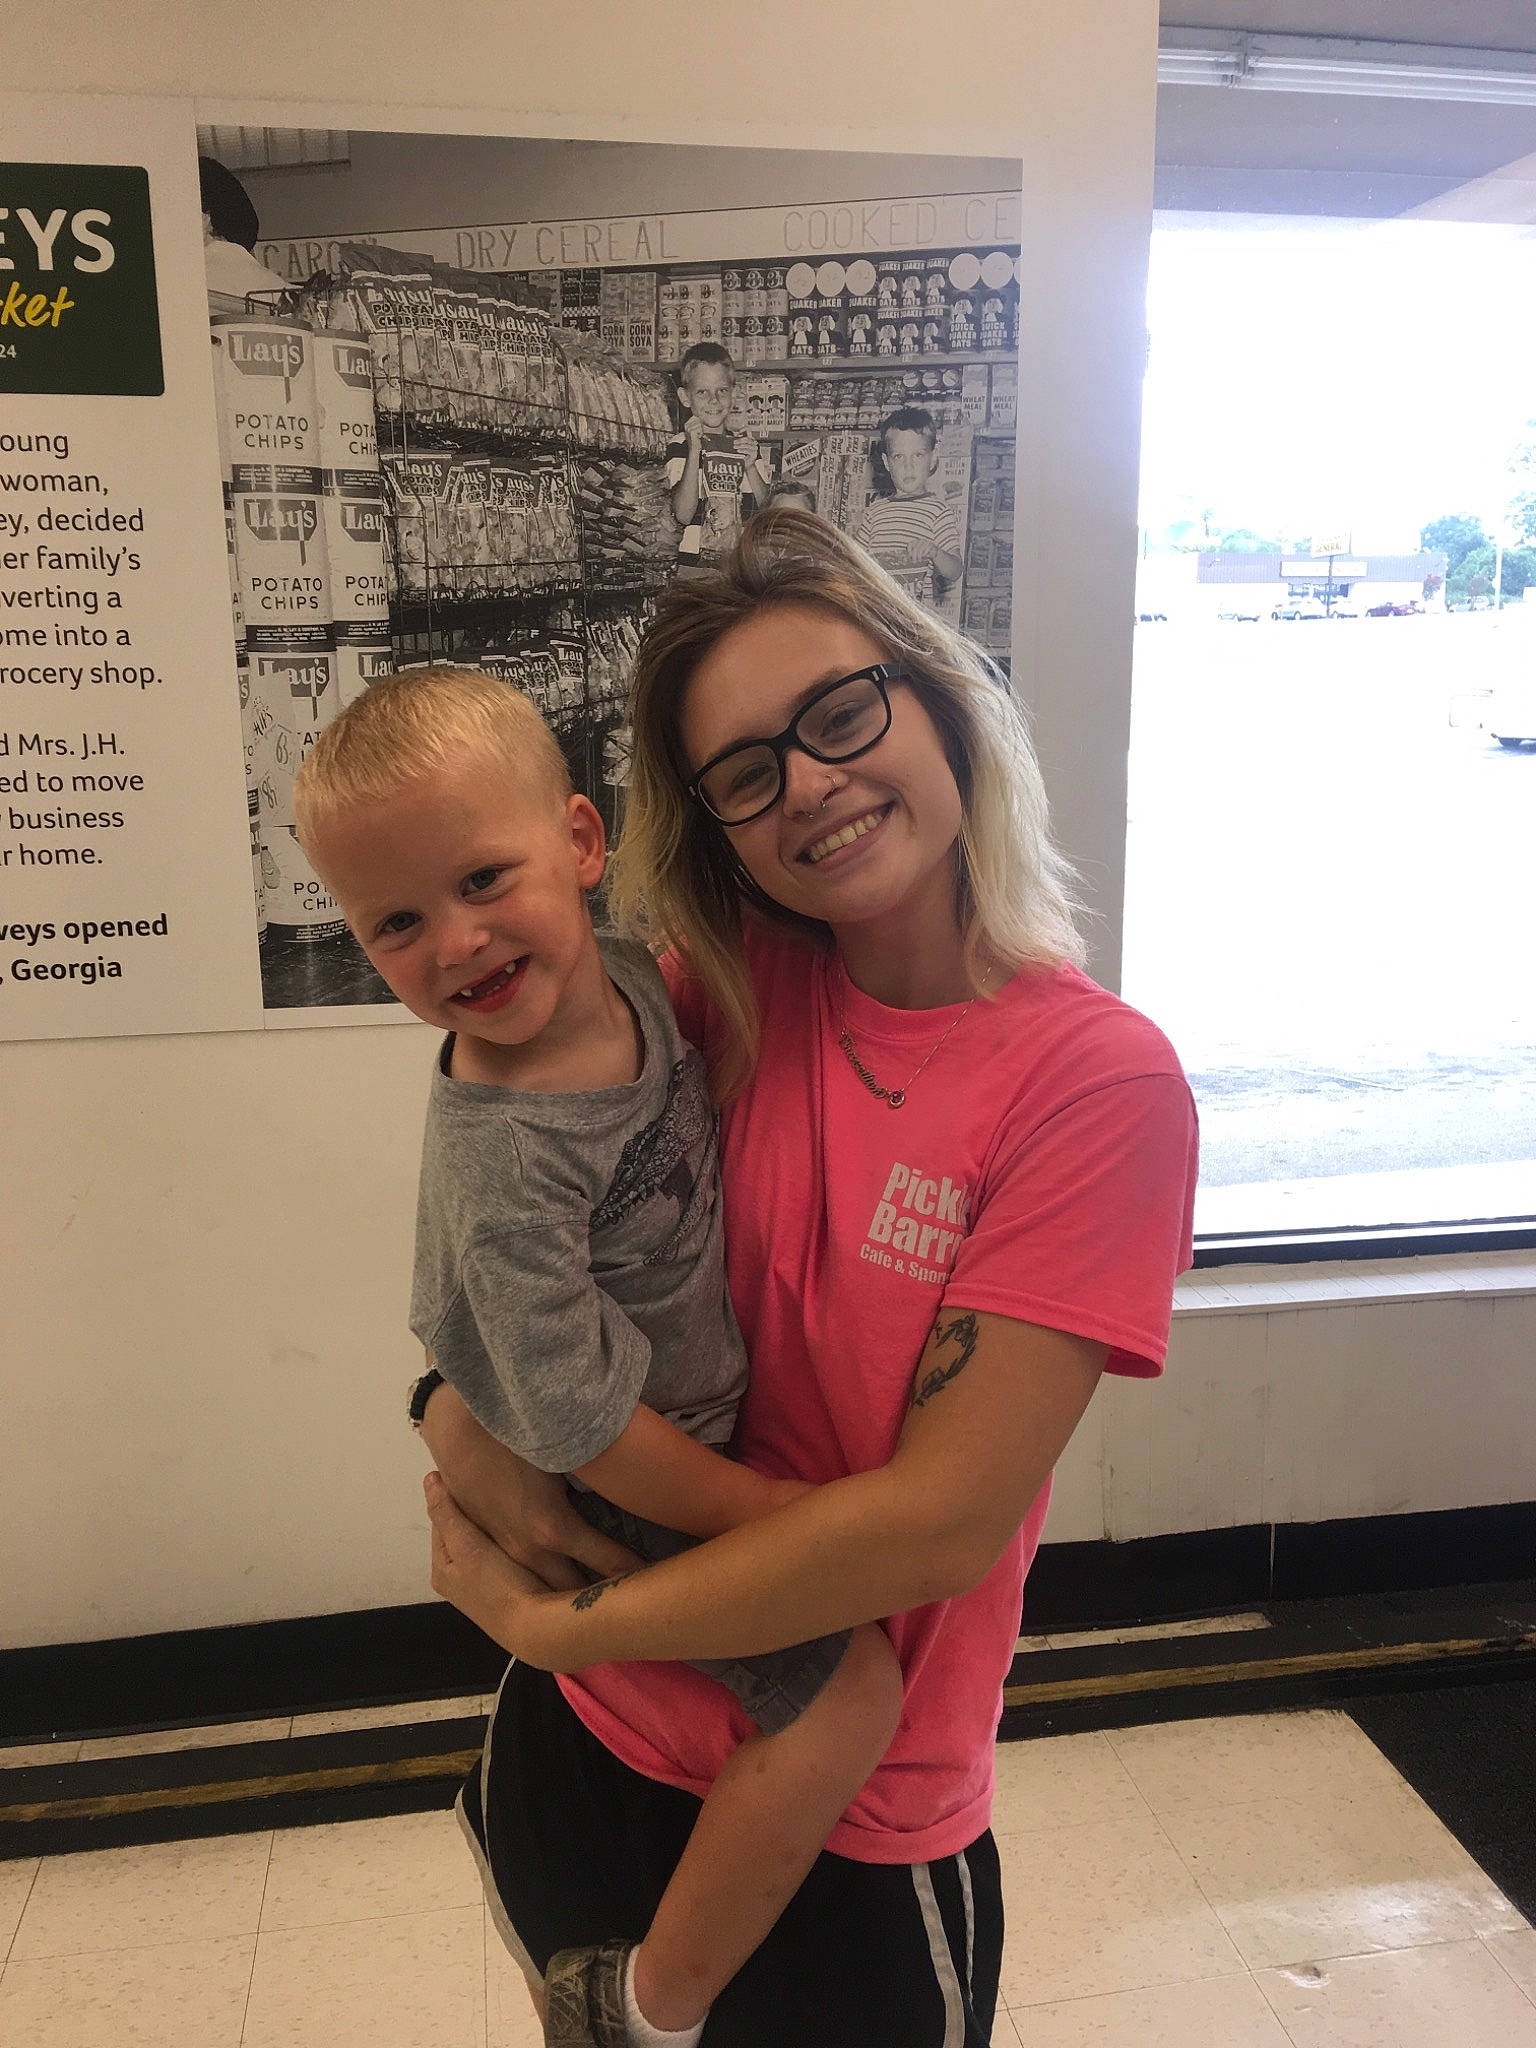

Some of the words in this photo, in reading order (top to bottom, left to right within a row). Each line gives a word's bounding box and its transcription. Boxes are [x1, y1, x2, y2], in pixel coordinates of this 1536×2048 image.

[784, 202, 937, 252] COOKED
[457, 228, 517, 269] DRY
[536, 219, 680, 266] CEREAL
[602, 325, 625, 336] CORN
[629, 324, 652, 336] CORN
[629, 336, 652, 348] SOYA
[232, 334, 301, 376] Lay's
[236, 413, 308, 431] POTATO
[244, 434, 304, 450] CHIPS
[784, 444, 817, 467] WHEATIES
[0, 474, 108, 496] woman,
[37, 507, 144, 532] decided
[247, 500, 315, 540] Lay's
[251, 577, 323, 592] POTATO
[107, 591, 123, 608] a
[261, 595, 319, 610] CHIPS
[54, 623, 108, 646] into
[116, 629, 132, 646] a
[0, 666, 83, 690] rocery
[91, 660, 163, 690] shop.
[19, 733, 75, 756] Mrs.
[81, 733, 126, 760] J.H.
[36, 772, 64, 793] to
[72, 774, 144, 792] move
[8, 806, 125, 829] business
[20, 843, 103, 866] home.
[63, 912, 168, 945] opened
[11, 955, 122, 985] Georgia
[895, 1259, 905, 1274] &
